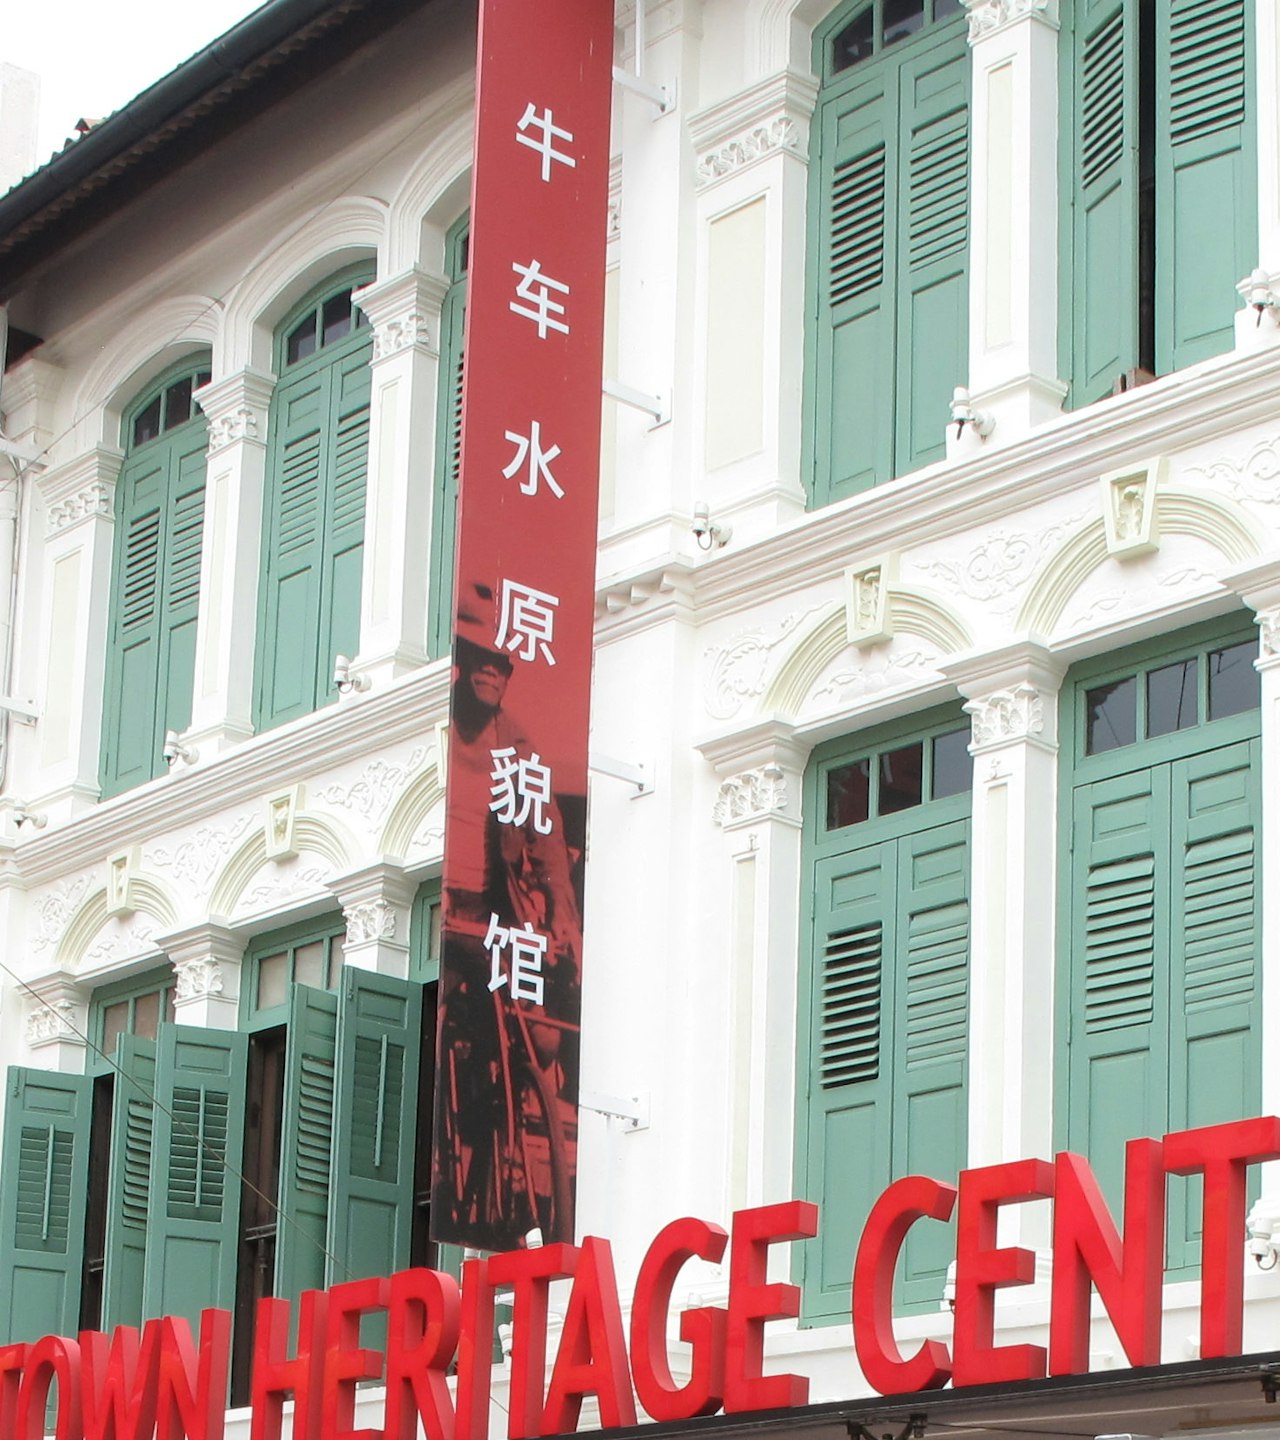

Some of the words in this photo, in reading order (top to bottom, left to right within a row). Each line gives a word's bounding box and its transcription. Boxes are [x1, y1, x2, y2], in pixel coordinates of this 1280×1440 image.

[481, 101, 576, 1006] 牛车水原貌馆
